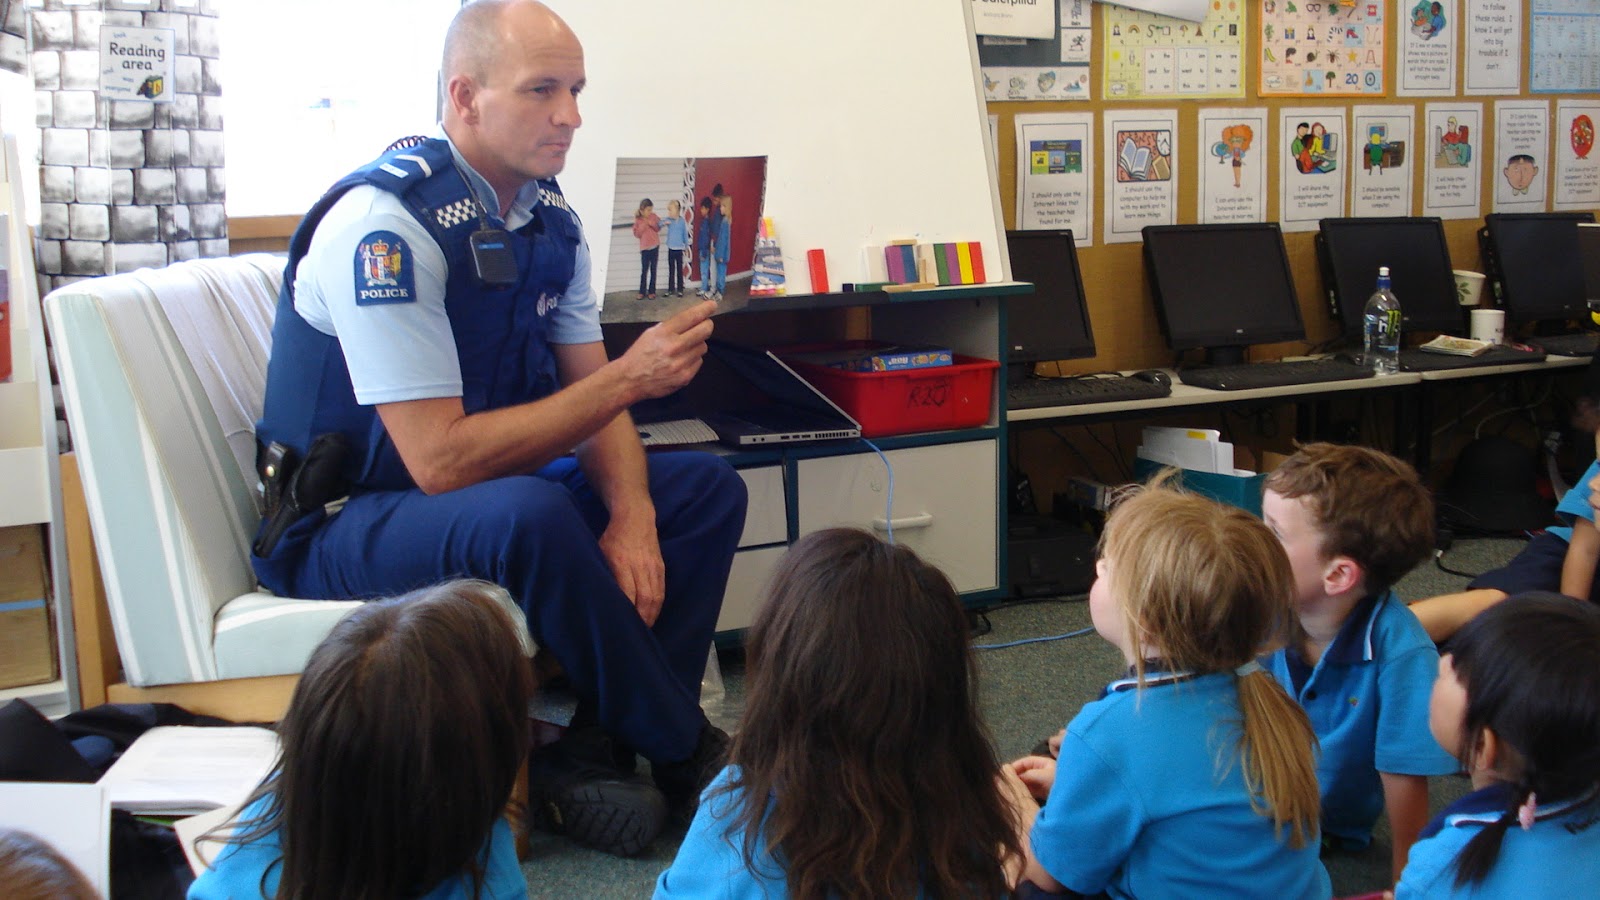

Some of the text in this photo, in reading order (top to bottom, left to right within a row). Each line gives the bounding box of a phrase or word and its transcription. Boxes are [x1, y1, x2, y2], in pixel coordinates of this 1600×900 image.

[109, 42, 166, 63] Reading
[122, 60, 153, 71] area
[1345, 72, 1359, 85] 20
[360, 288, 409, 300] POLICE
